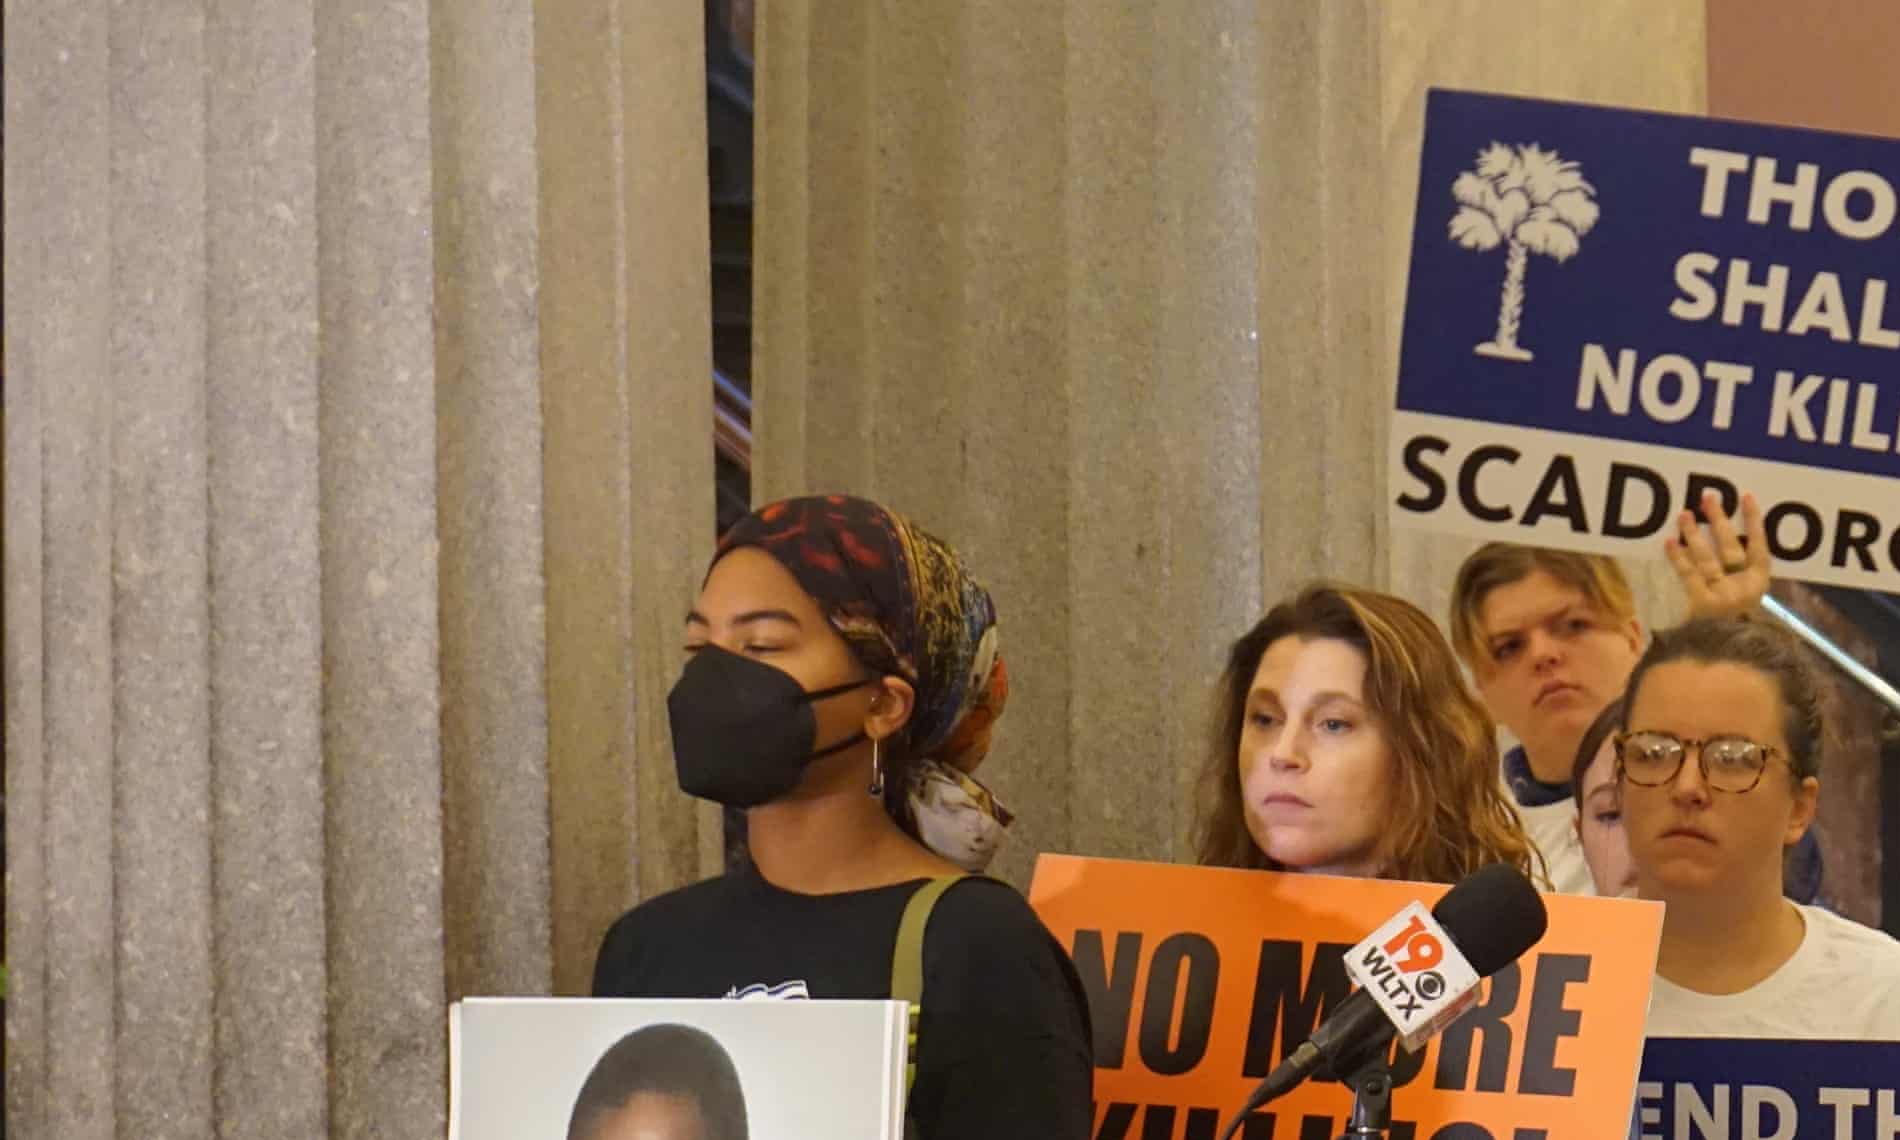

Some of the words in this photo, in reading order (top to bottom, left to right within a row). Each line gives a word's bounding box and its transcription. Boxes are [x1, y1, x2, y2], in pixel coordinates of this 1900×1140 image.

[1575, 343, 1753, 430] NOT
[1361, 945, 1425, 1021] WLTX
[1382, 914, 1444, 974] 19
[1070, 930, 1221, 1076] NO
